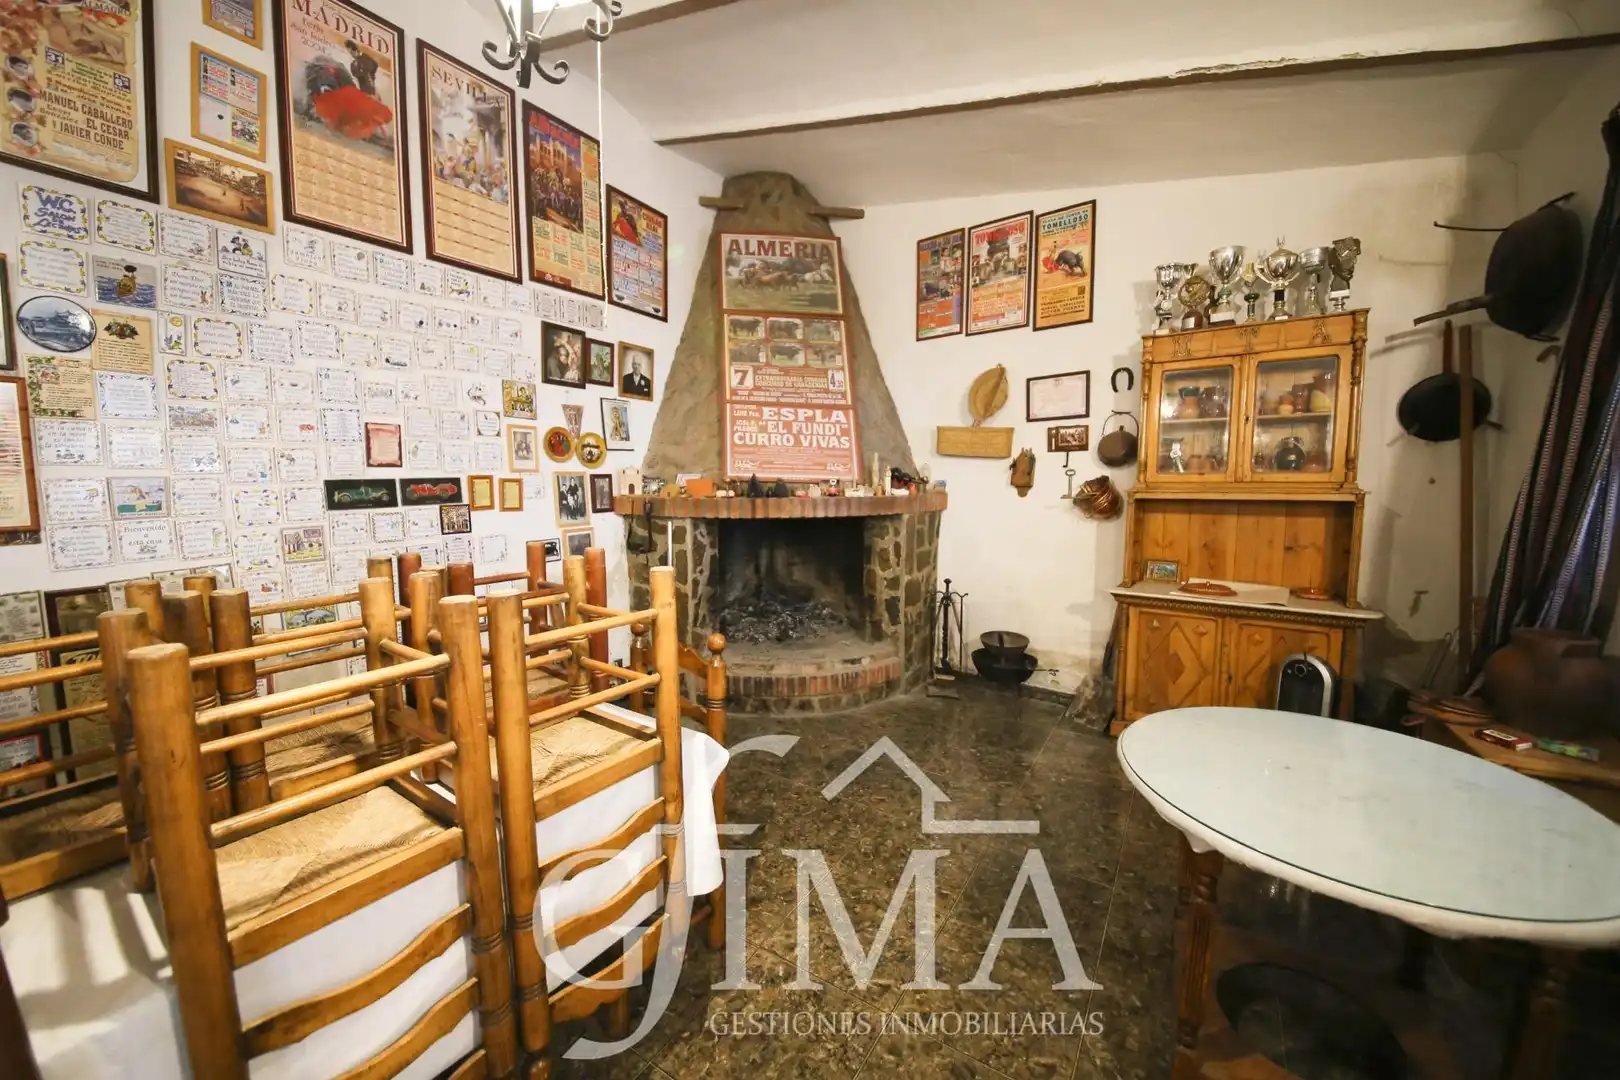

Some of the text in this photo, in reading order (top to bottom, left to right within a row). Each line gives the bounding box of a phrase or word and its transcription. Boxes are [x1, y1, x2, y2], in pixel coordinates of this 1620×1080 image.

[292, 0, 389, 55] MADRID
[39, 90, 79, 112] MANUEL
[81, 104, 133, 131] CABALLERO
[60, 121, 91, 141] JAVIER
[93, 132, 124, 150] CONDE
[86, 118, 130, 140] EL CESAR
[1042, 213, 1089, 230] TOMELLOSO
[727, 239, 835, 260] ALMERIA
[734, 369, 750, 386] 7
[762, 407, 848, 423] ESPLA
[733, 432, 850, 450] CURRO VIVAS
